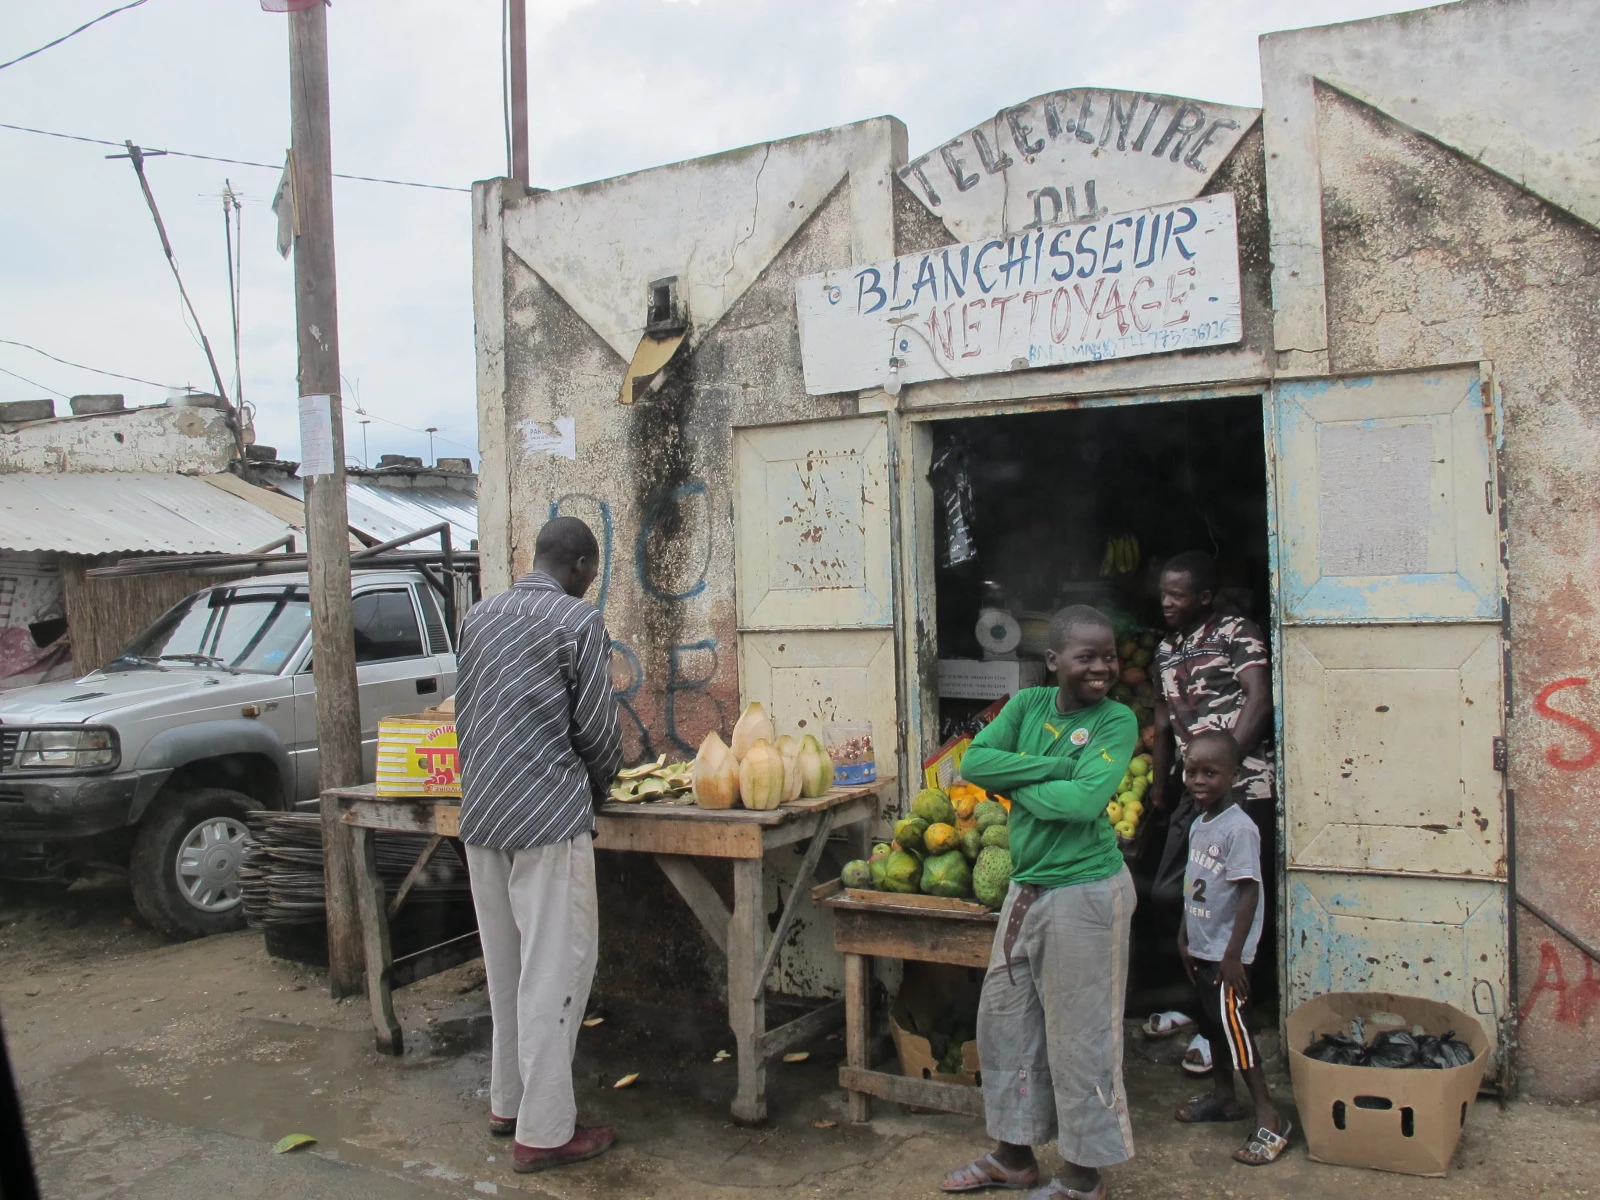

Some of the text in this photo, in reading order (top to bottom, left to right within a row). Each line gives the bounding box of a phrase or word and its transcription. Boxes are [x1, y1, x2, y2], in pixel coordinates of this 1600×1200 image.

[898, 88, 1241, 206] TELECENTRE
[1023, 180, 1107, 230] DU
[853, 206, 1199, 316] BLANCHISSEUR
[923, 267, 1196, 360] NETTOYAGE
[428, 725, 456, 740] MIUM
[1192, 878, 1206, 902] 2
